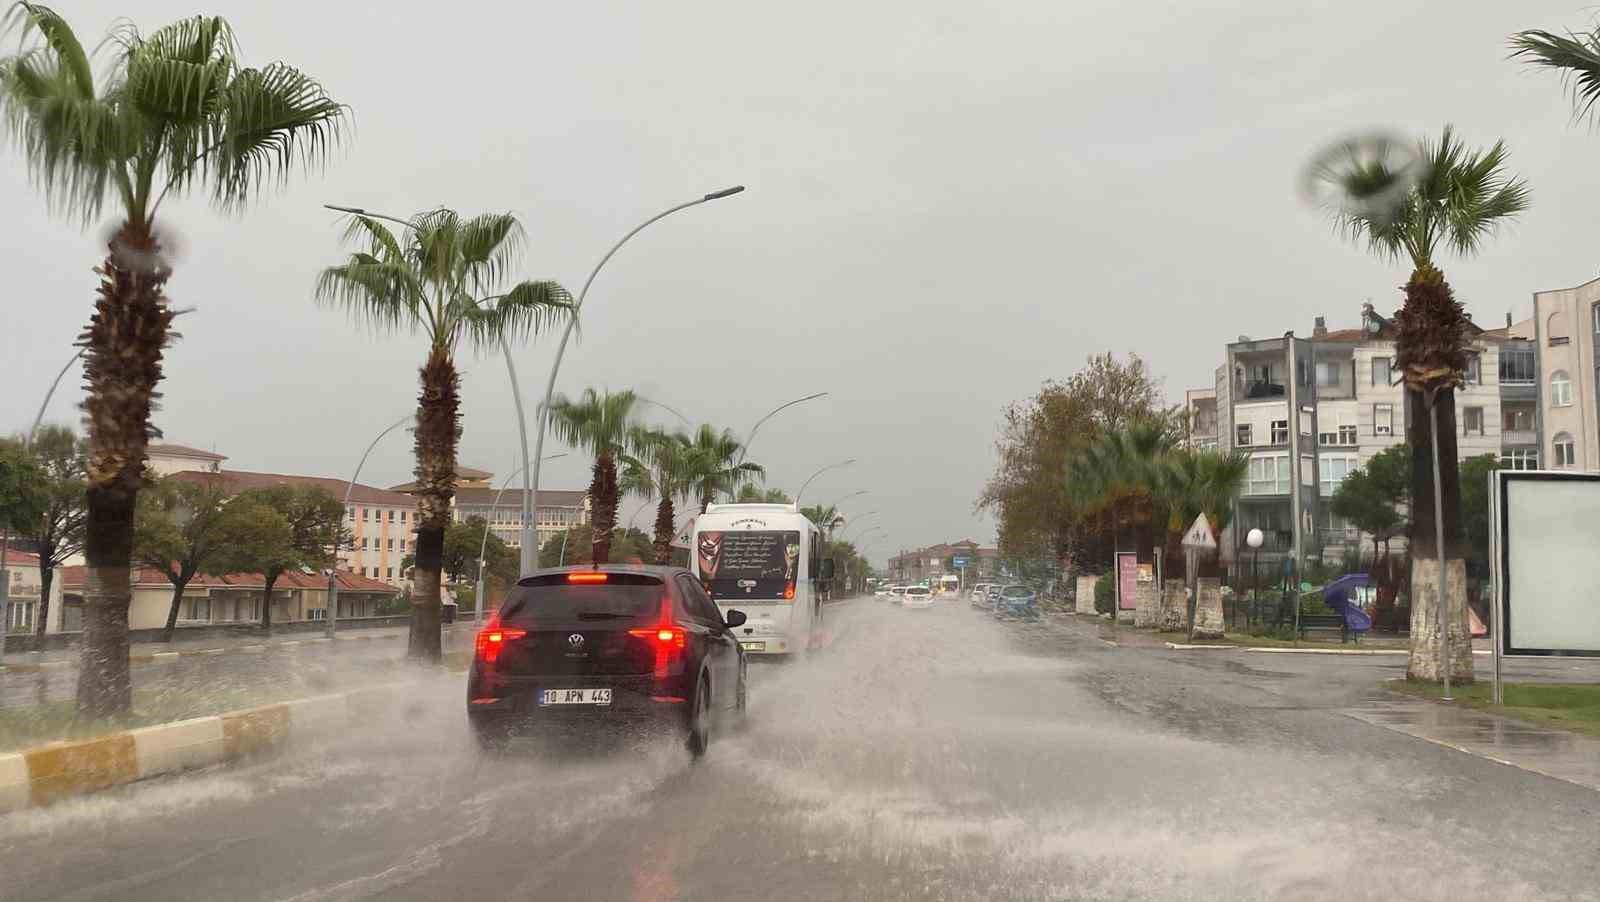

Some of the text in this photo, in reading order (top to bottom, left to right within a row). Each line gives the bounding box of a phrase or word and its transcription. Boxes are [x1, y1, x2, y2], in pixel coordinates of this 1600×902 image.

[545, 689, 610, 703] 10 APN 443
